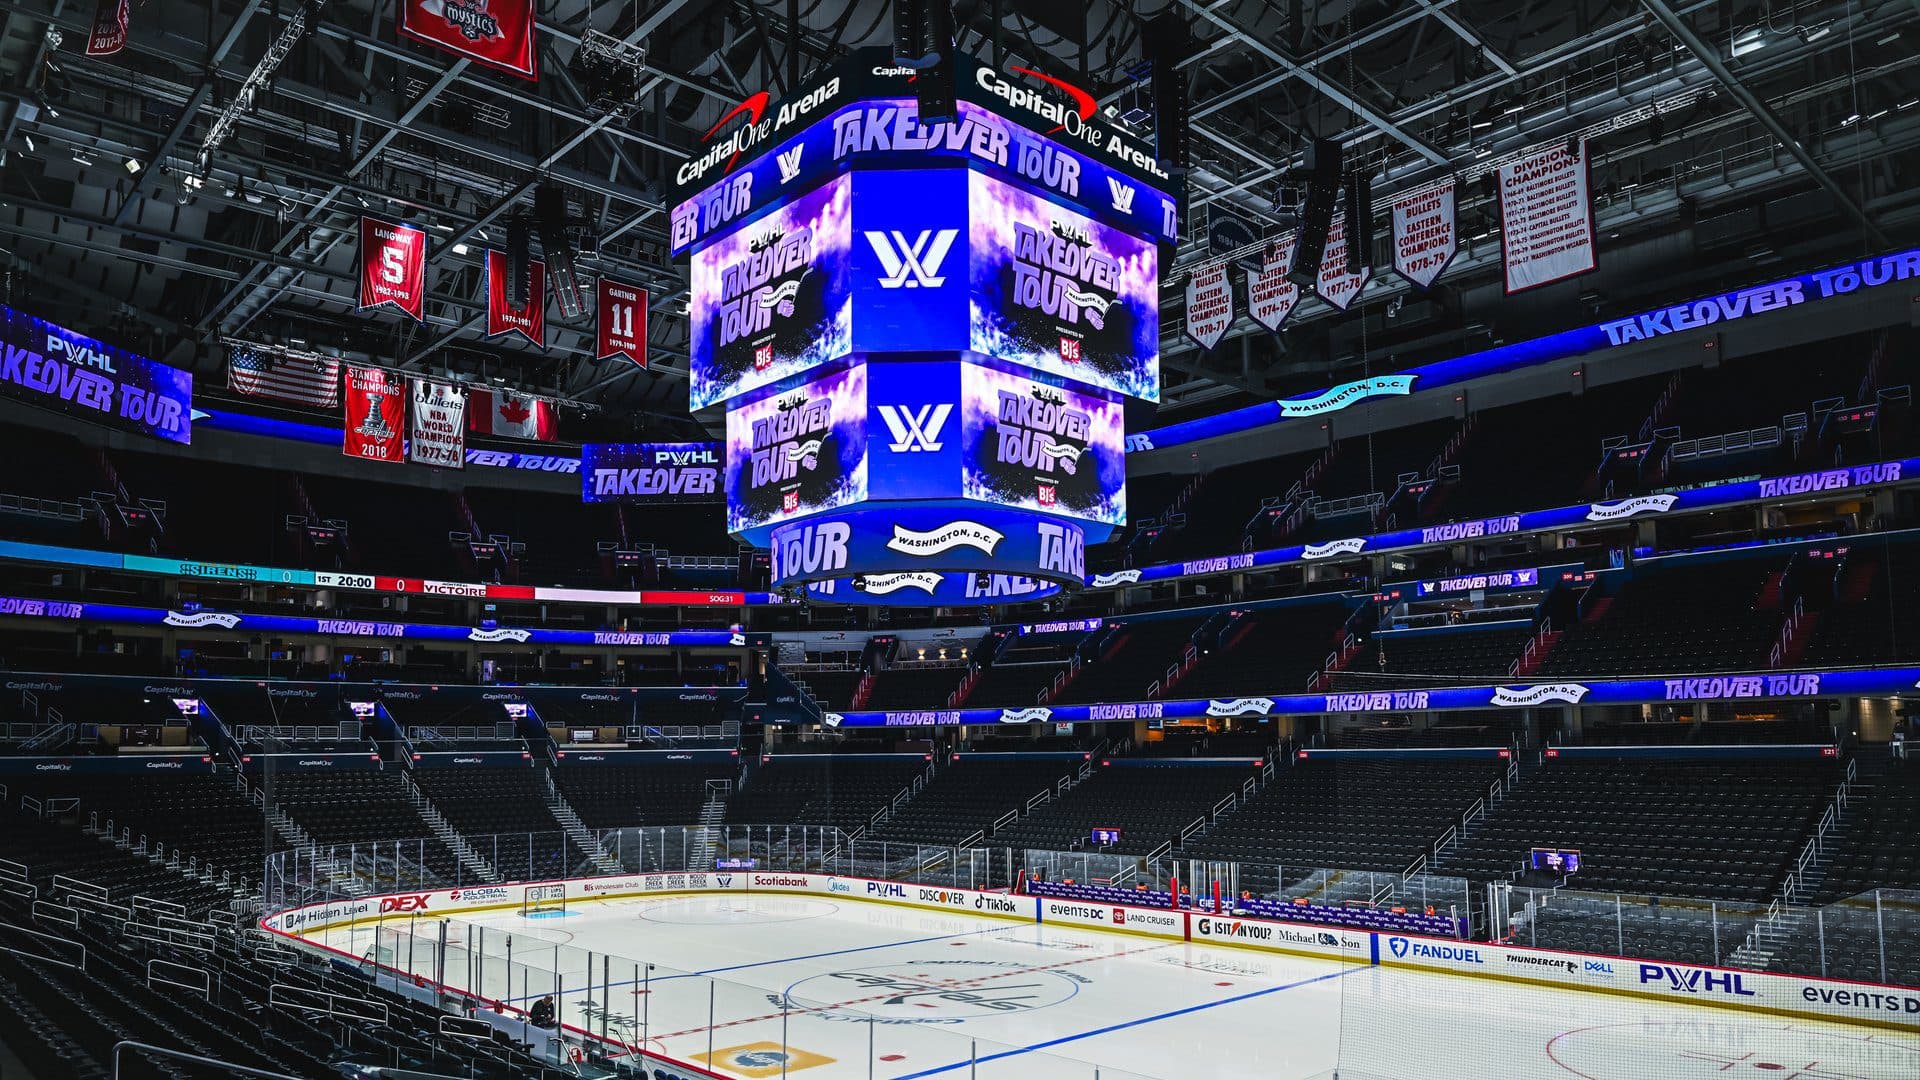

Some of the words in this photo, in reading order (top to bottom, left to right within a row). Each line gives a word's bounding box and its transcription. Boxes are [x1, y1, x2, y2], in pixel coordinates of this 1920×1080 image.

[447, 5, 494, 34] mystics
[774, 76, 840, 132] Arena
[1015, 134, 1082, 197] TOUR
[1505, 155, 1581, 188] CHAMPIONS
[1513, 148, 1569, 175] DIVISION
[1526, 177, 1554, 192] BALTIMORE
[1554, 169, 1576, 182] BULLETS
[1527, 187, 1555, 202] BALTIMORE
[1555, 180, 1576, 192] BULLETS
[703, 171, 753, 233] TOUR
[1406, 198, 1441, 219] BULLETS
[1527, 197, 1556, 212] BALTIMORE
[1556, 190, 1577, 202] BULLETS
[1528, 207, 1556, 222] BALTIMORE
[1556, 200, 1578, 213] BULLETS
[1406, 214, 1442, 234] EASTERN
[1529, 220, 1549, 231] CAPITAL
[1549, 213, 1571, 225] BULLETS
[1530, 224, 1564, 241] WASHINGTON
[1564, 218, 1585, 230] BULLETS
[374, 227, 413, 245] LANGWAY
[1398, 222, 1451, 247] CONFERENCE
[1530, 234, 1565, 251] WASHINGTON
[1565, 228, 1586, 240] BULLETS
[1400, 235, 1449, 258] CHAMPIONS
[1531, 245, 1565, 260] WASHINGTON
[1565, 237, 1589, 250] WIZARDS
[382, 246, 405, 285] 5
[722, 228, 813, 302] TAKEOVER
[1013, 221, 1122, 294] TAKEOVER
[1406, 252, 1446, 274] 1978-79
[1195, 273, 1223, 289] BULLETS
[1326, 276, 1360, 297] 1977-78
[609, 287, 637, 301] GARTNER
[1012, 260, 1081, 324] TOUR
[1195, 287, 1223, 302] EASTERN
[1252, 284, 1293, 304] CHAMPIONS
[1189, 294, 1230, 314] CONFERENCE
[1190, 304, 1228, 323] CHAMPIONS
[1257, 300, 1290, 318] 1974-75
[611, 303, 634, 338] 11
[720, 286, 774, 347] TOUR
[1195, 320, 1225, 337] 1970-71
[47, 334, 118, 375] PWHL
[1060, 339, 1079, 359] BJ's
[1289, 380, 1370, 414] WASHINGTON,
[1376, 378, 1406, 390] D.C.
[1600, 281, 1805, 347] TAKEOVER
[348, 368, 385, 382] STANLEY
[351, 379, 400, 396] CHAMPIONS
[119, 382, 183, 433] TOUR
[415, 393, 463, 410] bullets
[430, 410, 447, 422] NBA
[751, 398, 832, 450] TAKEOVER
[998, 389, 1092, 442] TAKEOVER
[423, 420, 453, 433] WORLD
[414, 430, 463, 446] CHAMPIONS
[996, 424, 1057, 473] TOUR
[361, 443, 387, 458] 2018
[417, 444, 459, 461] 1977-78
[655, 451, 719, 466] PWHL
[516, 453, 582, 474] TOUR
[751, 441, 799, 489] TOUR
[594, 467, 718, 495] TAKEOVER
[1183, 558, 1229, 576] TAKEOVER
[1230, 554, 1254, 570] TOUR
[1306, 540, 1347, 557] WASHINGTON,
[1422, 522, 1484, 544] TAKEOVER
[1486, 516, 1520, 535] TOUR
[1594, 498, 1649, 519] WASHINGTON,
[1652, 498, 1669, 507] D.C.
[1759, 470, 1849, 499] TAKEOVER
[1852, 462, 1902, 486] TOUR
[781, 521, 851, 579] TOUR
[898, 527, 971, 548] WASHINGTON,
[973, 530, 993, 545] D.C.
[282, 571, 291, 583] 0
[317, 575, 332, 584] 1ST
[338, 575, 372, 588] 20:00
[396, 579, 405, 591] 0
[708, 594, 733, 603] SOG:31
[917, 573, 934, 585] D.C.
[1440, 576, 1487, 592] TAKEOVER
[1488, 573, 1513, 587] TOUR
[47, 601, 83, 619] TOUR
[170, 614, 219, 625] WASHINGTON,
[220, 615, 233, 624] D.C.
[317, 620, 374, 636] TAKEOVER
[376, 623, 405, 637] TOUR
[474, 630, 513, 641] WASHINGTON,
[594, 632, 643, 645] TAKEOVER
[645, 633, 670, 645] TOUR
[1034, 621, 1068, 633] TAKEOVER
[1068, 621, 1085, 631] TOUR
[885, 712, 935, 726] TAKEOVER
[937, 711, 960, 725] TOUR
[1089, 704, 1136, 721] TAKEOVER
[1138, 703, 1163, 718] TOUR
[1212, 700, 1254, 713] WASHINGTON,
[1325, 692, 1391, 713] TAKEOVER
[1394, 691, 1429, 710] TOUR
[1499, 685, 1557, 704] WASHINGTON,
[1560, 687, 1578, 697] D.C.
[1664, 676, 1763, 700] TAKEOVER
[1767, 674, 1820, 696] TOUR
[1823, 748, 1835, 756] 121
[463, 887, 508, 896] GLOBAL
[754, 875, 809, 887] Scotiabank
[867, 882, 907, 897] PWHL
[379, 894, 431, 913] DEX
[463, 893, 508, 901] INDUSTRIAL
[920, 888, 965, 905] DISCOVER
[985, 896, 1016, 913] TikTok
[1050, 903, 1089, 918] events
[1090, 908, 1104, 920] DC
[1126, 913, 1145, 924] LAND
[1145, 915, 1175, 927] CRUISER
[1248, 925, 1272, 940] YOU?
[1278, 929, 1316, 944] Michael
[1341, 936, 1360, 949] Son
[1413, 943, 1484, 964] FANDUEL
[1506, 954, 1566, 968] THUNDERCAT
[1584, 961, 1614, 973] DELL
[1639, 964, 1756, 996] PWHL
[1802, 985, 1900, 1011] events
